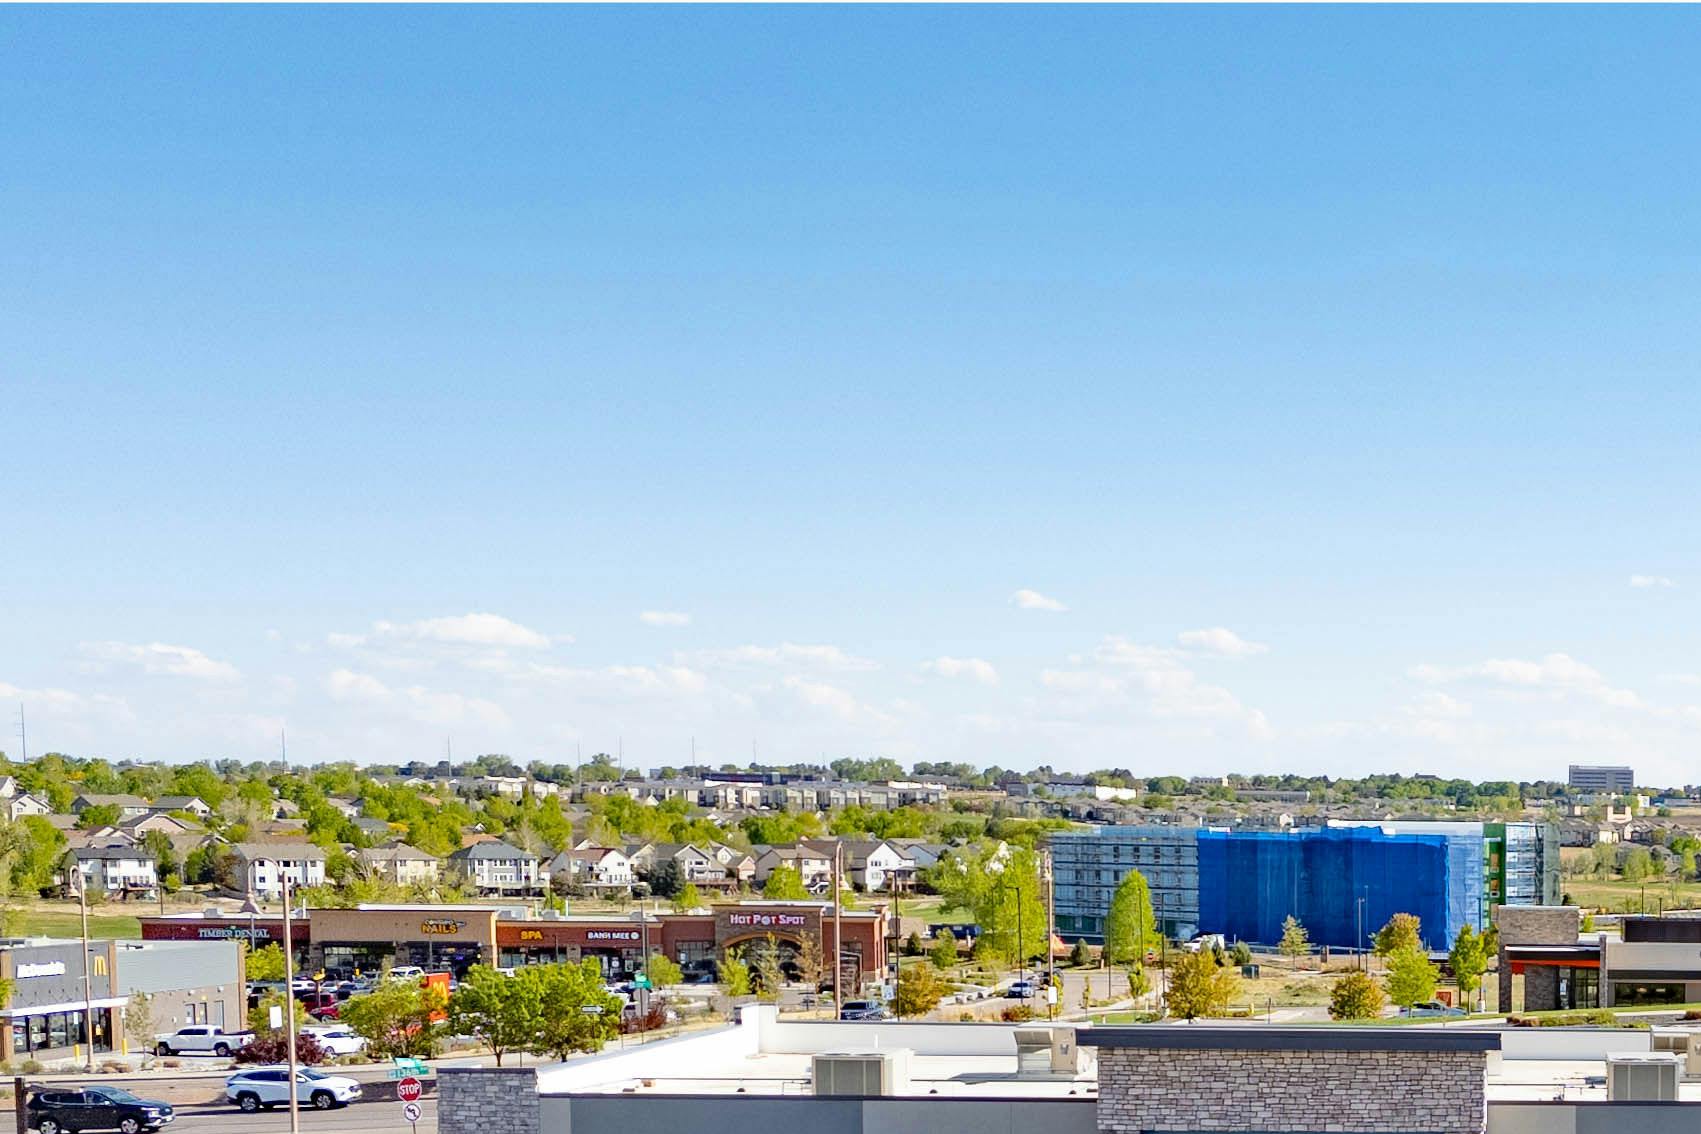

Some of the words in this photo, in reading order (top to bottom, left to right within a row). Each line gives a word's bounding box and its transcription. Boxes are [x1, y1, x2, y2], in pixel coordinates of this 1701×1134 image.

[730, 914, 751, 924] HOT
[778, 914, 806, 924] SPOT
[422, 923, 457, 934] NAILS
[520, 930, 543, 940] SPA
[400, 1083, 420, 1096] STOP
